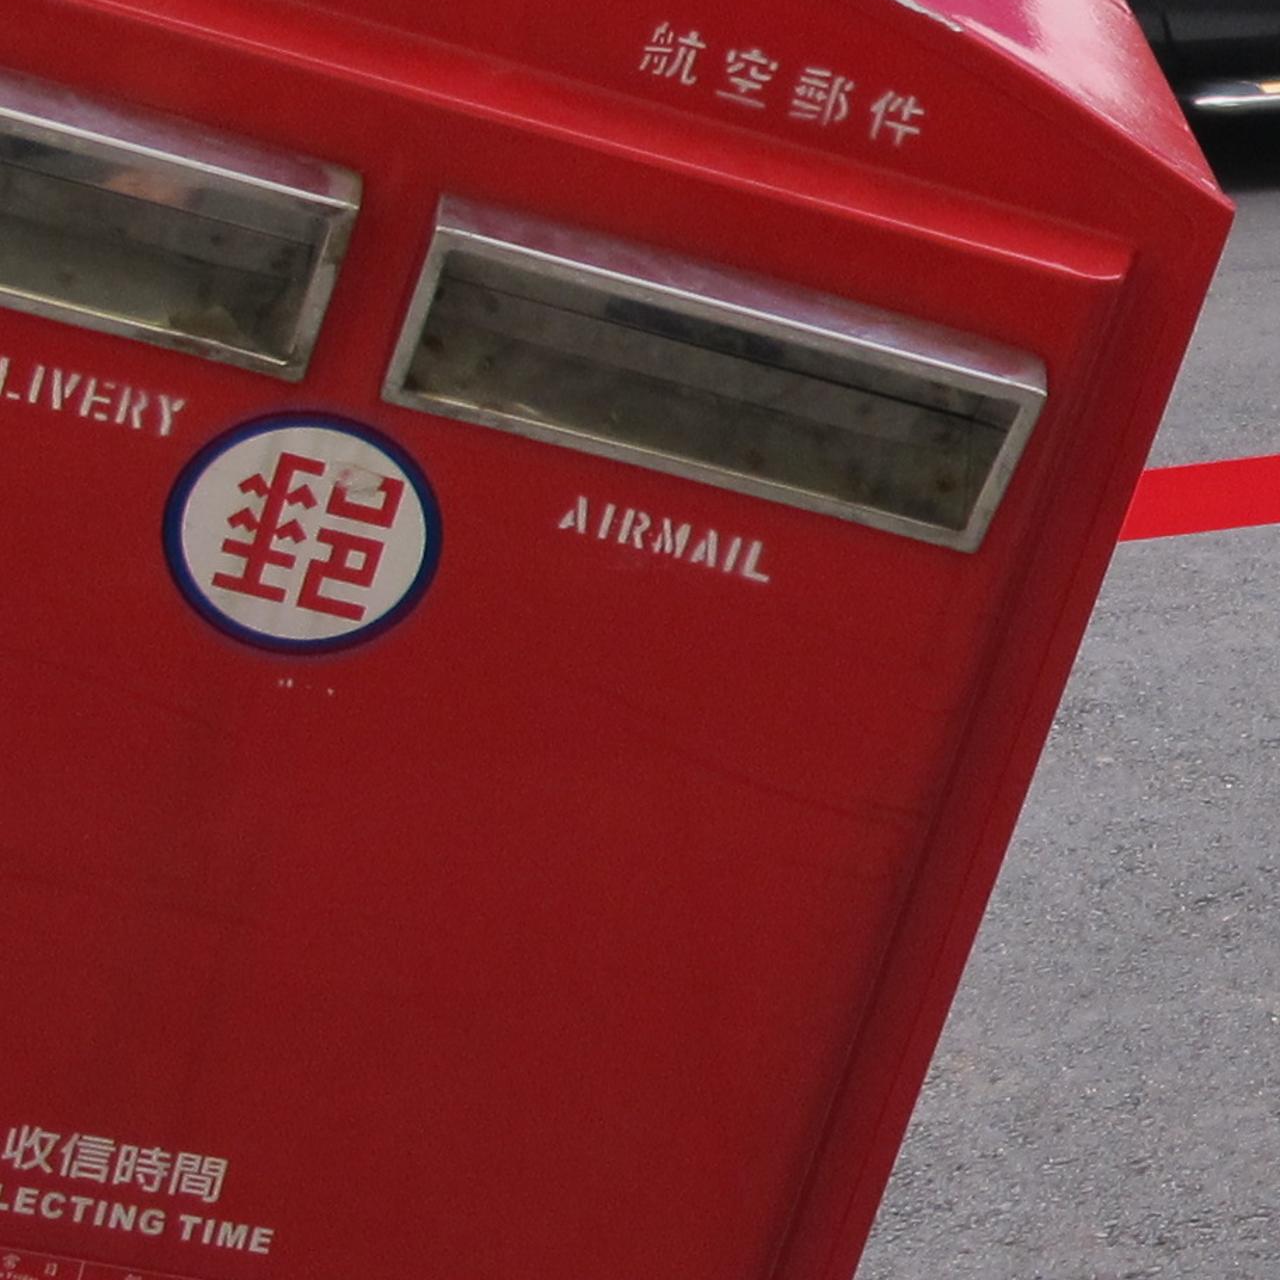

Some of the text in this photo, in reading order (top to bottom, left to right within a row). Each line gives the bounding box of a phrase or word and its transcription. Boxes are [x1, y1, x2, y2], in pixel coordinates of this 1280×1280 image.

[638, 21, 925, 145] 航空郵件
[558, 495, 771, 583] AIRMAIL
[1, 1124, 229, 1204] 收信時間
[178, 1213, 276, 1255] TIME
